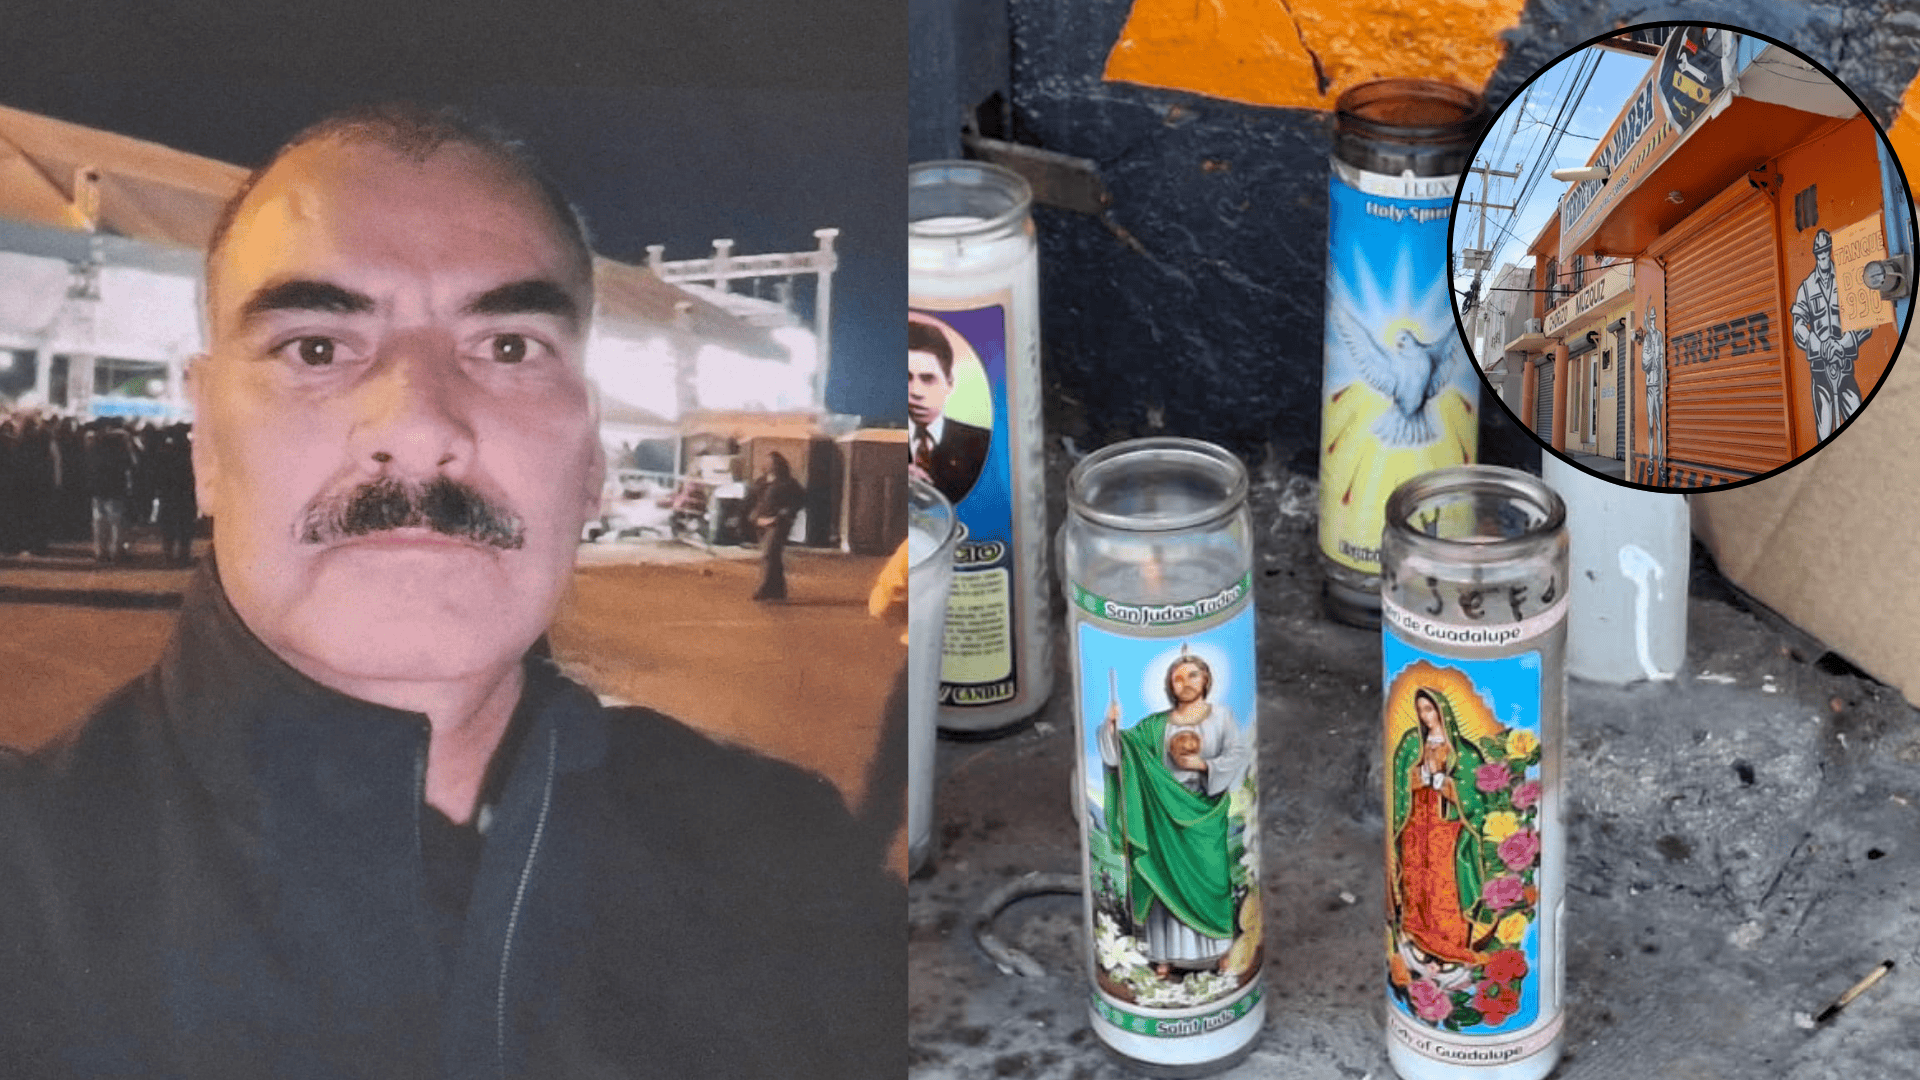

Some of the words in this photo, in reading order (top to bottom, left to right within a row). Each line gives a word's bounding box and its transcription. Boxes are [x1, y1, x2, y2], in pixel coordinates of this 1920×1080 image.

[1365, 201, 1406, 222] Holy
[1834, 230, 1884, 266] TANQUE
[1671, 312, 1772, 367] TRUPER
[1105, 602, 1140, 622] San
[1141, 605, 1194, 626] Judas
[1403, 617, 1420, 632] de
[1425, 624, 1521, 644] Guadalupe
[1157, 1019, 1199, 1035] Saint
[1416, 1039, 1431, 1052] of
[1436, 1044, 1523, 1061] Guadalupe
